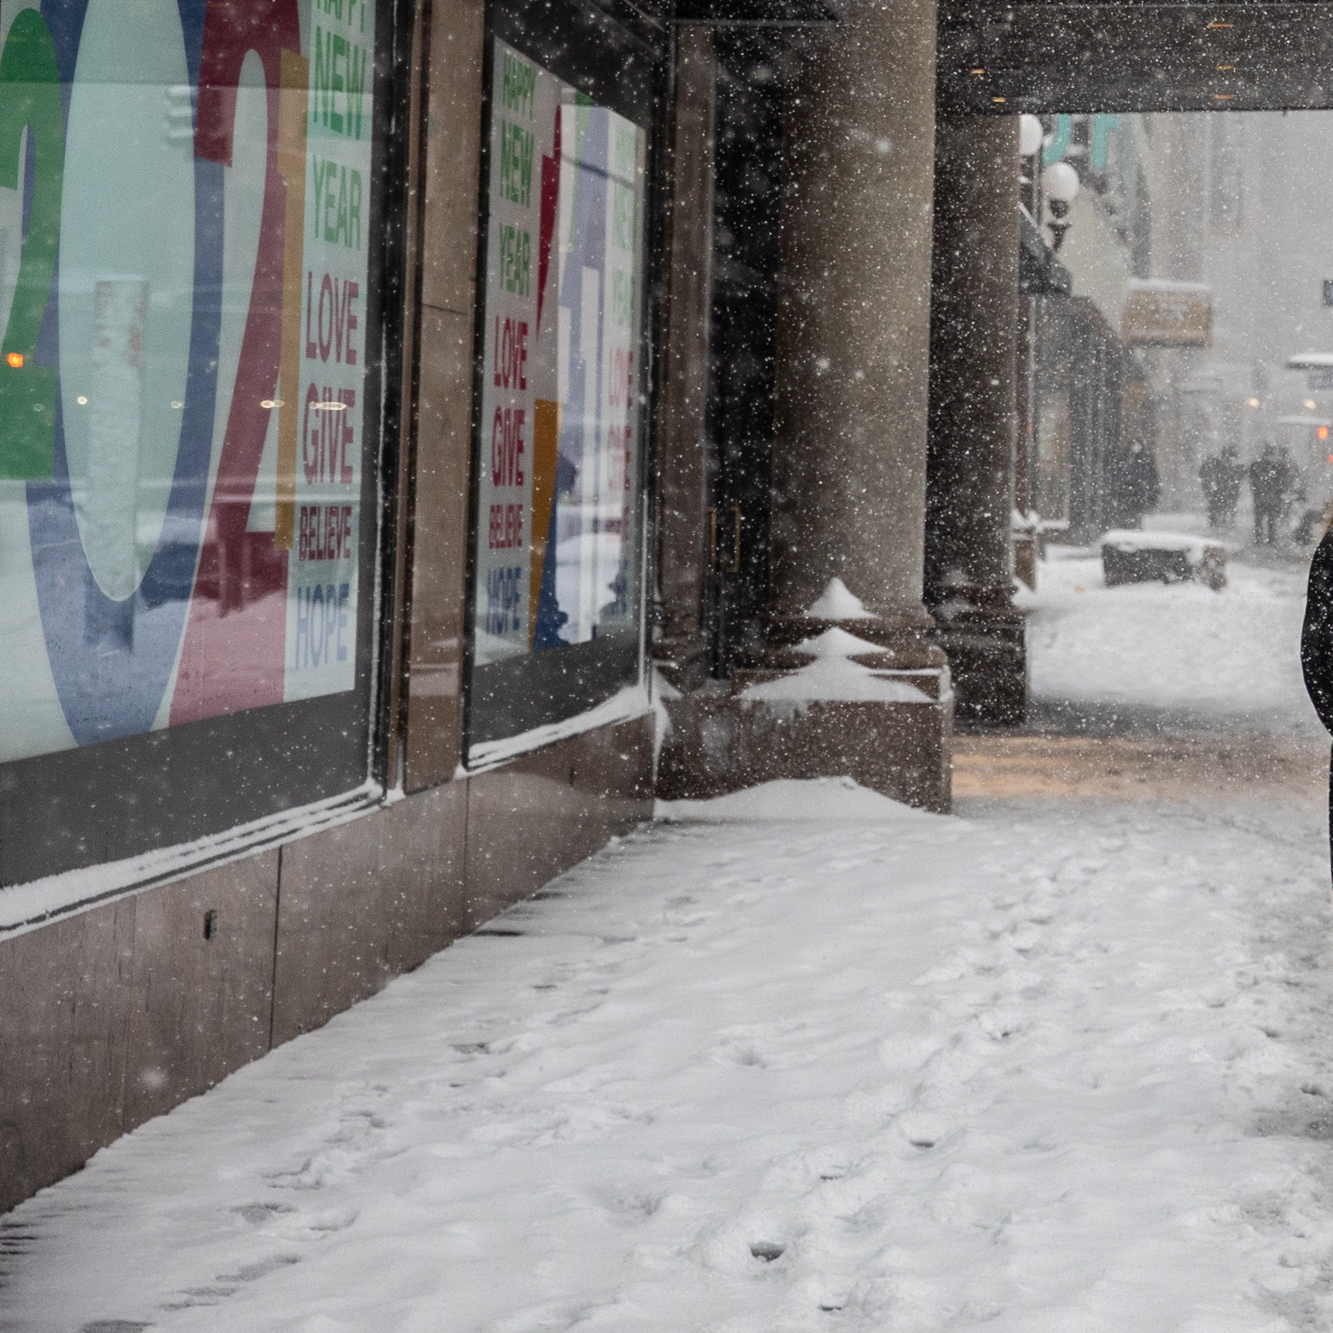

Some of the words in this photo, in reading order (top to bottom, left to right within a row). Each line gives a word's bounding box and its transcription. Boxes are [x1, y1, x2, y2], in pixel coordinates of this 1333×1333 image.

[312, 24, 367, 141] NEW
[502, 51, 536, 122] HAPPY
[313, 154, 362, 251] YEAR
[500, 118, 535, 208] NEW
[499, 221, 531, 298] YEAR
[306, 270, 359, 366] LOVE
[494, 315, 528, 391] LOVE
[303, 382, 356, 484] GIVE
[491, 405, 525, 487] GIVE
[299, 505, 352, 562] BELIEVE
[488, 504, 523, 550] BELIEVE
[296, 582, 350, 670] HOPE
[485, 567, 522, 635] HOPE
